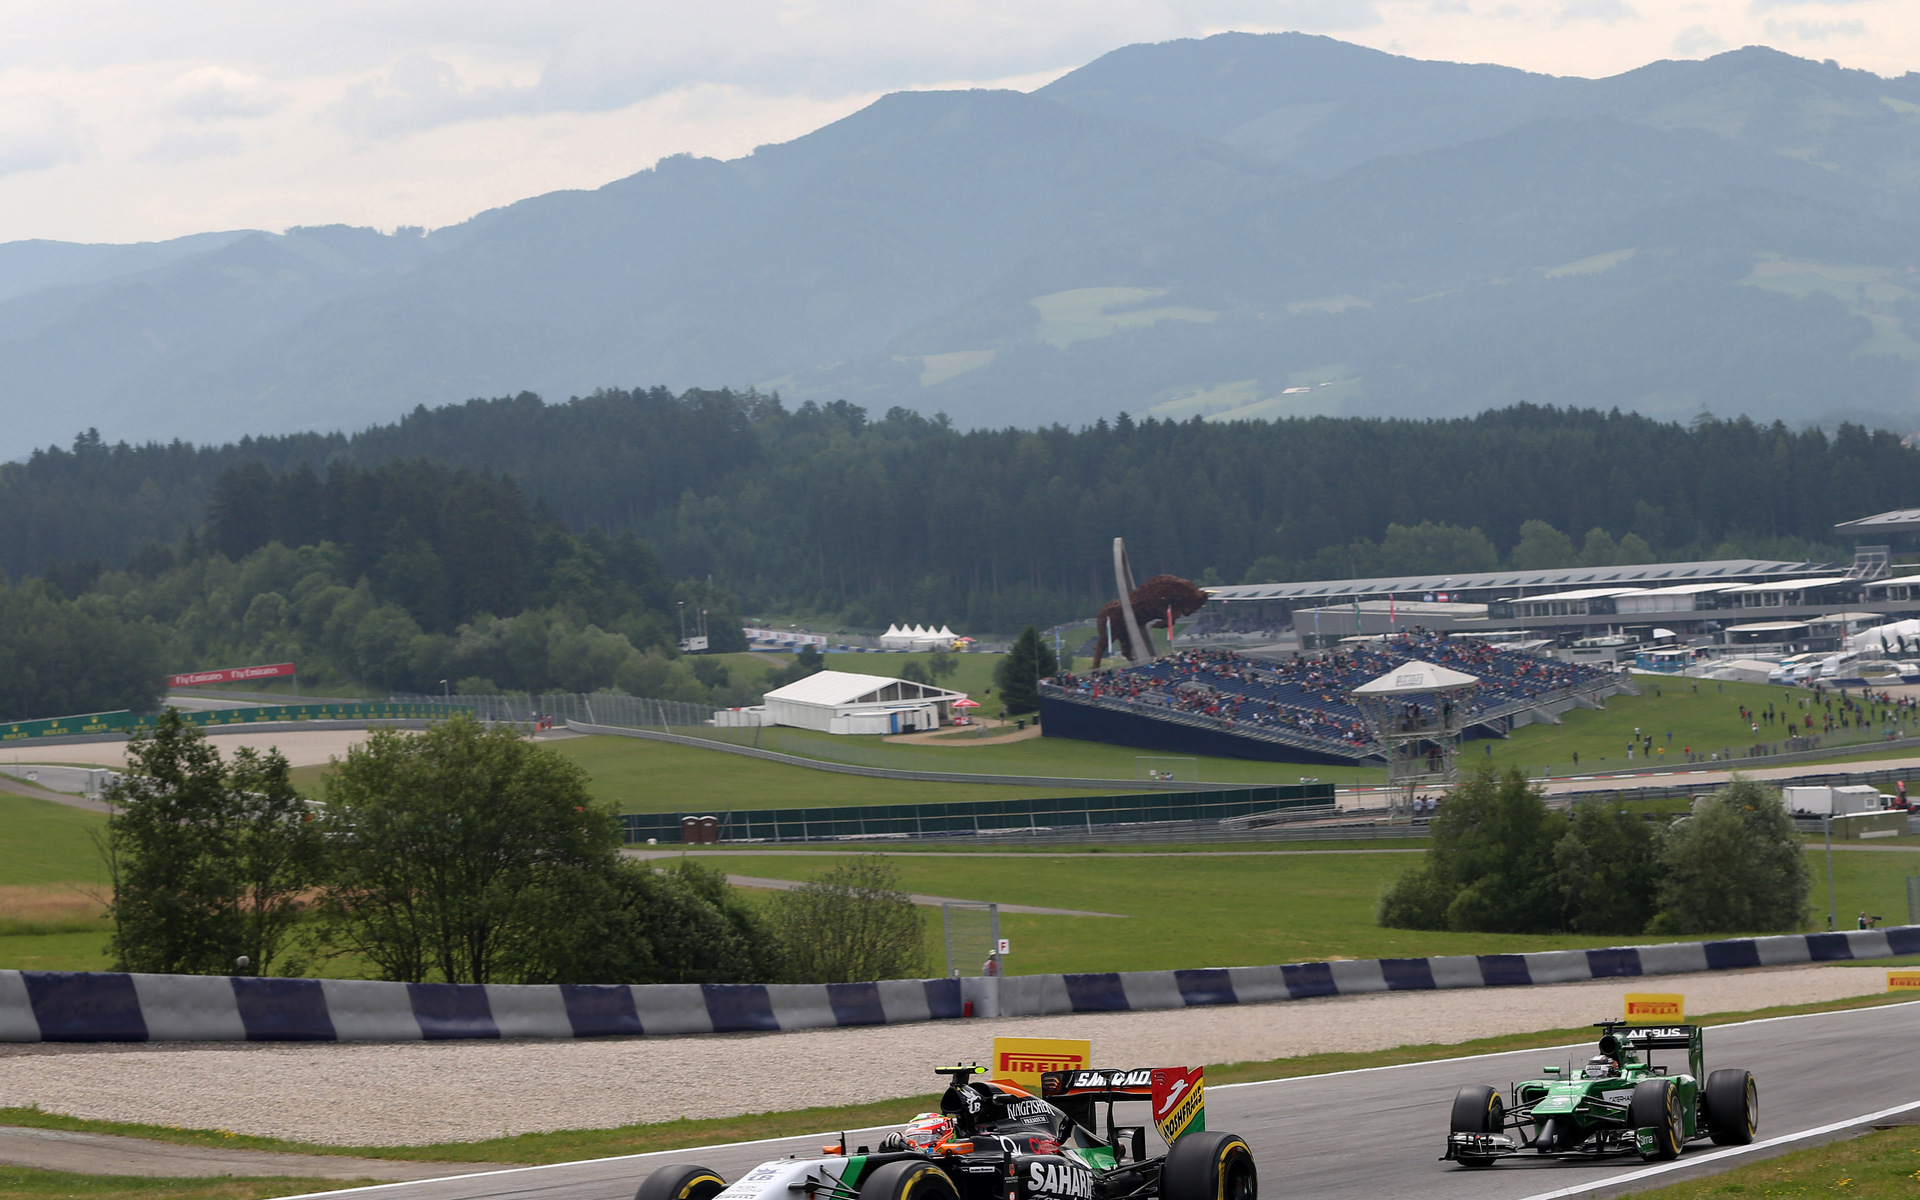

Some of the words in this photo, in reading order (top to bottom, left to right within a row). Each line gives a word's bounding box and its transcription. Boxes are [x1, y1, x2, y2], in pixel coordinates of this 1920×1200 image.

[231, 670, 245, 678] Fly
[245, 667, 278, 677] Emirates
[176, 676, 189, 684] Fly
[189, 673, 223, 683] Emirates
[82, 723, 108, 731] ROLEX
[3, 732, 29, 740] ROLEX
[1001, 941, 1006, 951] F
[1890, 977, 1920, 986] PIREL
[1628, 1003, 1680, 1014] PIRELLI
[1000, 1053, 1082, 1072] PIRELLI
[1007, 1100, 1056, 1120] KINGFISHER
